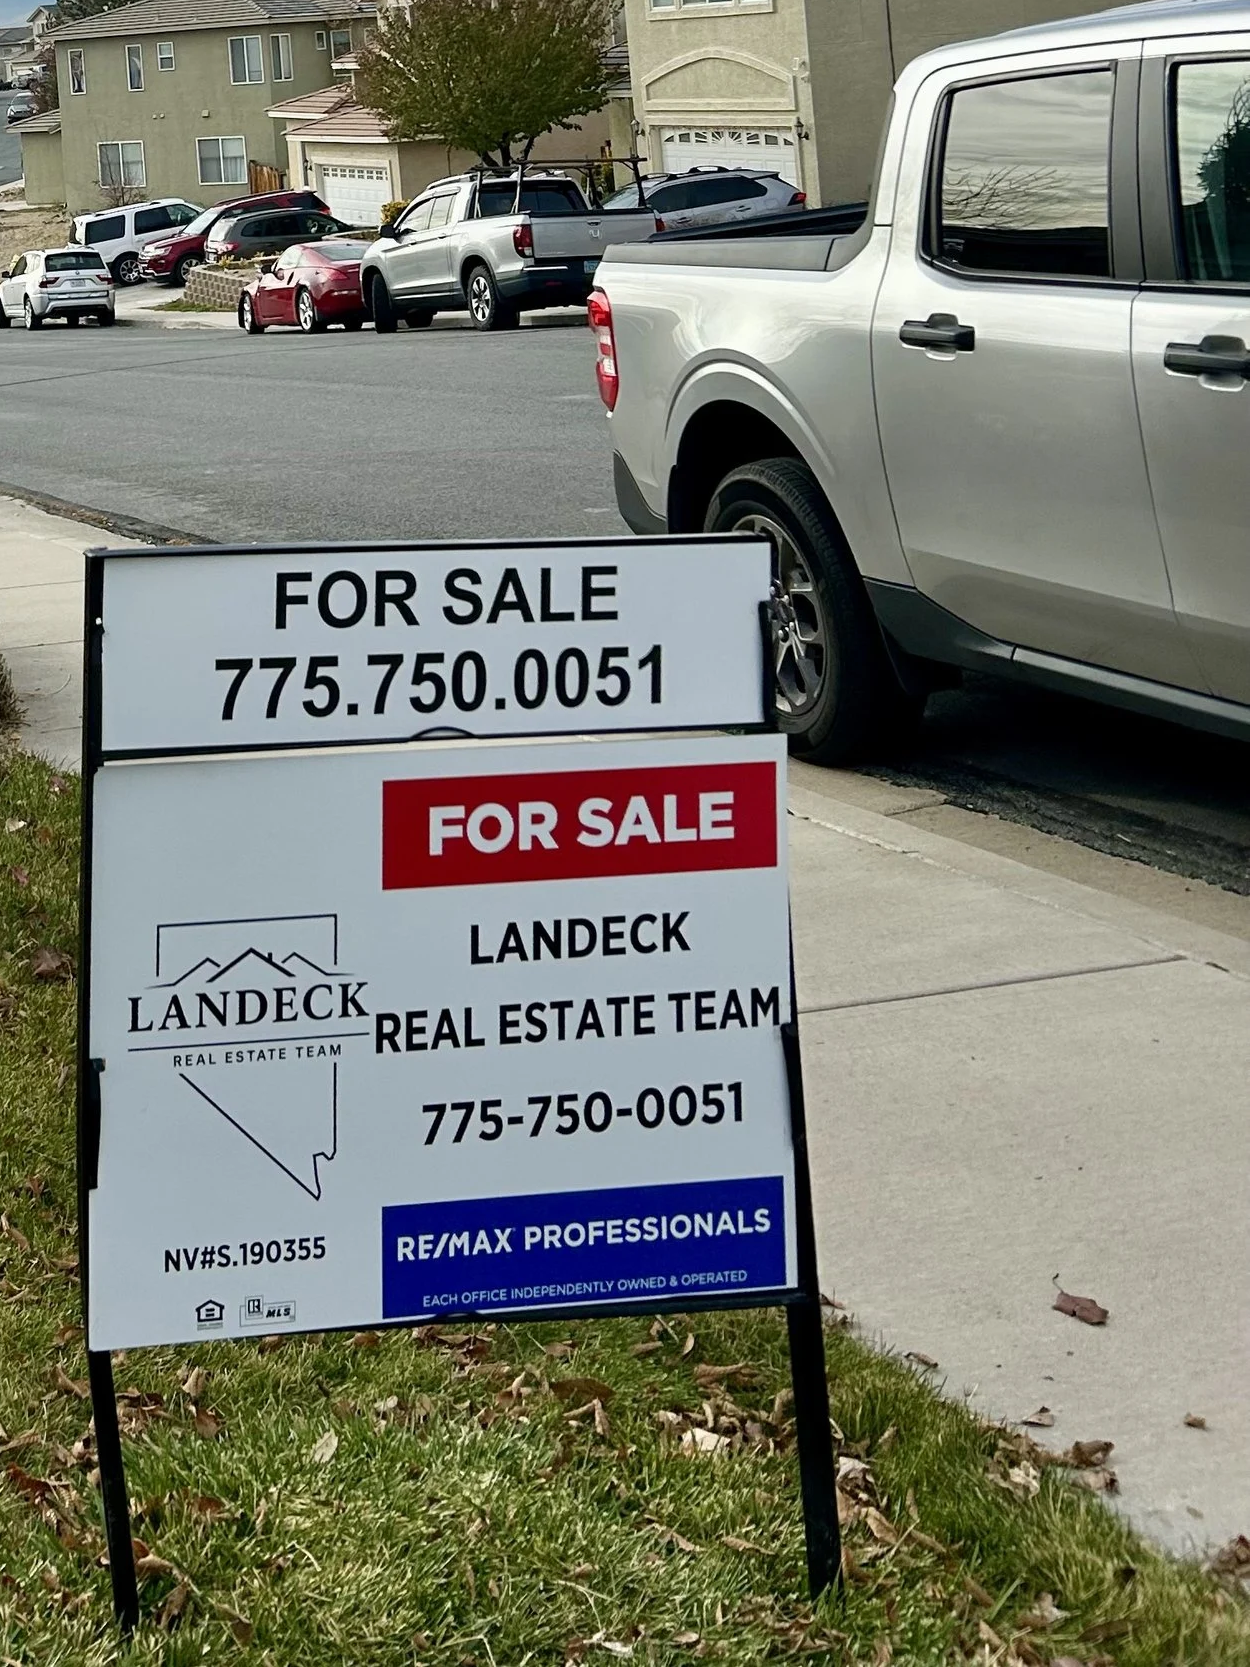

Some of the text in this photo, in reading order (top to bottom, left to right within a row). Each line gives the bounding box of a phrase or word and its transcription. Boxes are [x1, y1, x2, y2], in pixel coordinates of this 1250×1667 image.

[274, 565, 619, 630] FOR SALE
[214, 644, 663, 722] 775.750.0051
[428, 791, 735, 857] FOR SALE
[469, 911, 691, 965] LANDECK
[127, 982, 370, 1032] LANDECK
[374, 986, 781, 1055] REAL ESTATE TEAM
[173, 1044, 342, 1067] REAL ESTATE TEAM
[422, 1081, 744, 1146] 775-750-0051
[164, 1236, 327, 1274] NV#S.190355
[397, 1208, 771, 1262] RE/MAX PROFESSIONALS
[265, 1307, 291, 1319] MLS
[423, 1270, 748, 1308] EACH OFFICE INDEPENDENTLY OWNED & OPERATED
